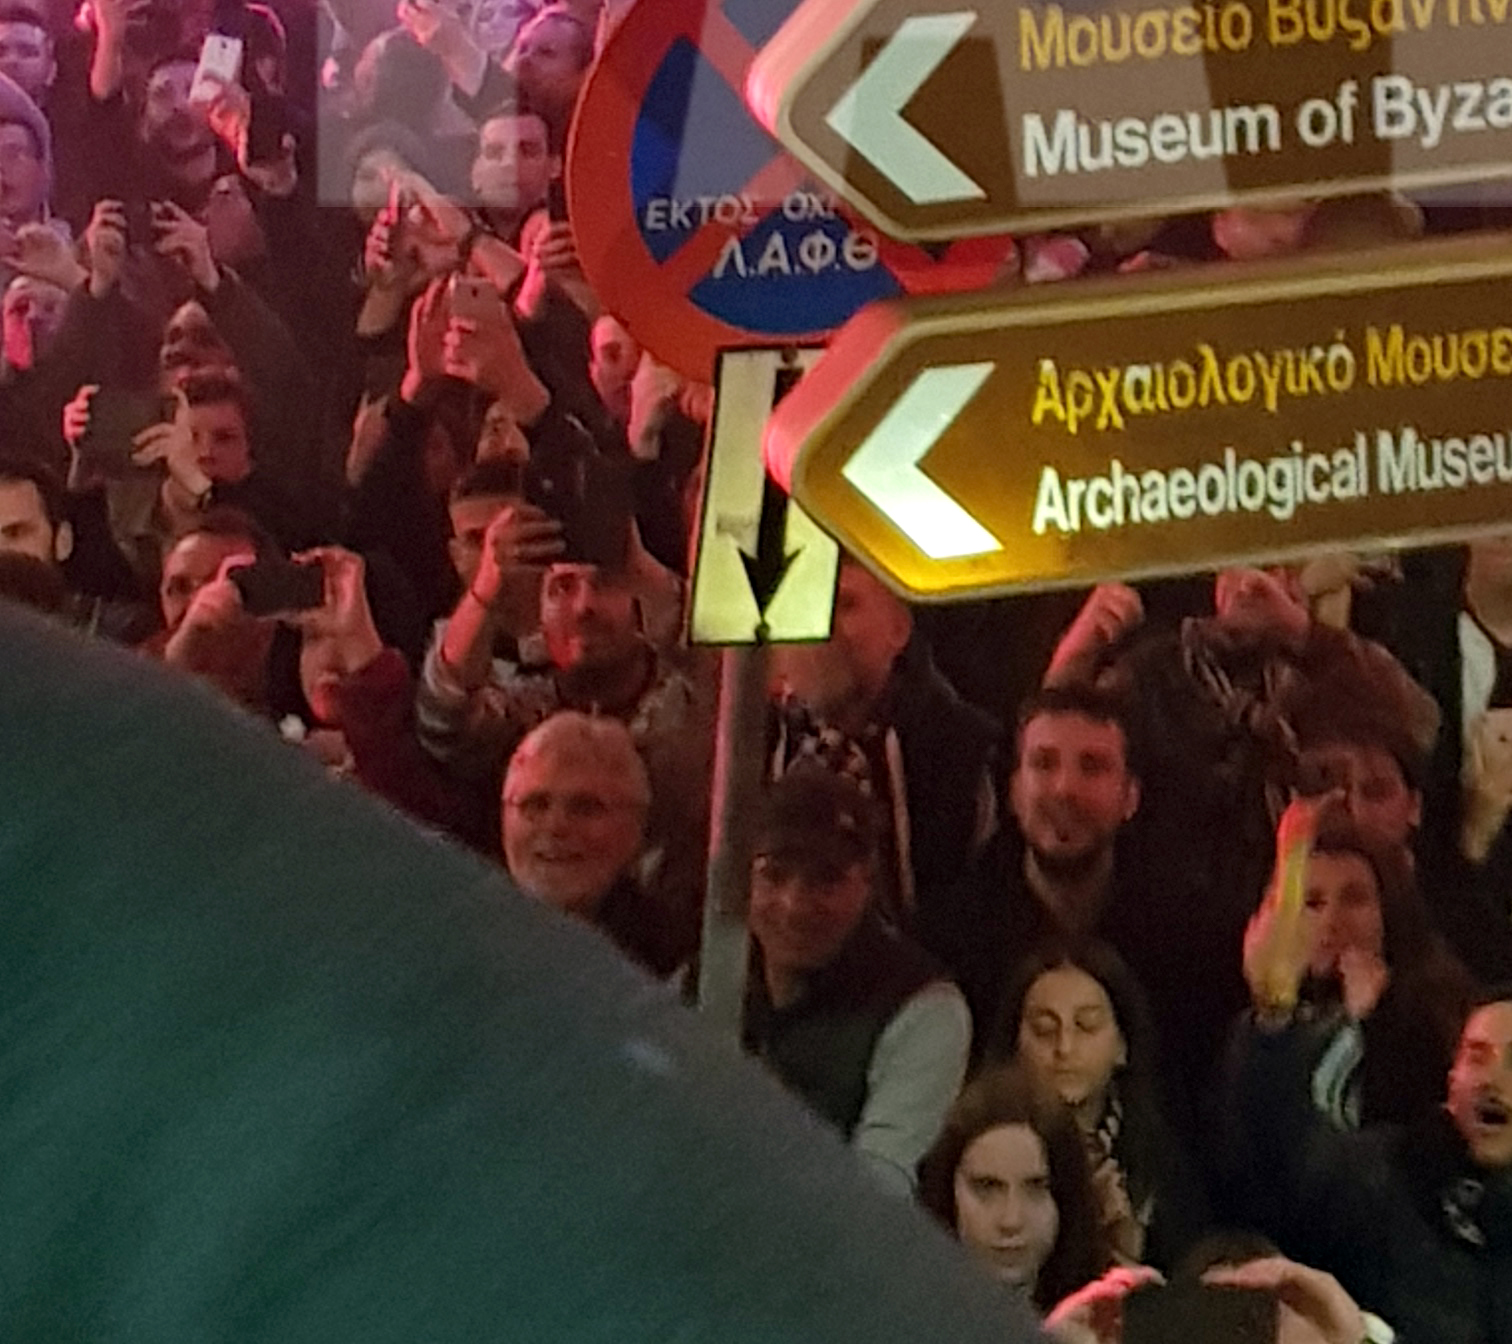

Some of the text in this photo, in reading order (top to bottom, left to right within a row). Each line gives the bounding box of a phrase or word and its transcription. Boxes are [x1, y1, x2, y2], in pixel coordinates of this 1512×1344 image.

[1021, 102, 1282, 178] Museum
[1296, 79, 1359, 147] of
[645, 191, 760, 231] ΕΚΤΟΣ
[1031, 328, 1356, 435] Αρχαιολογικό
[1031, 429, 1368, 536] Archaeological
